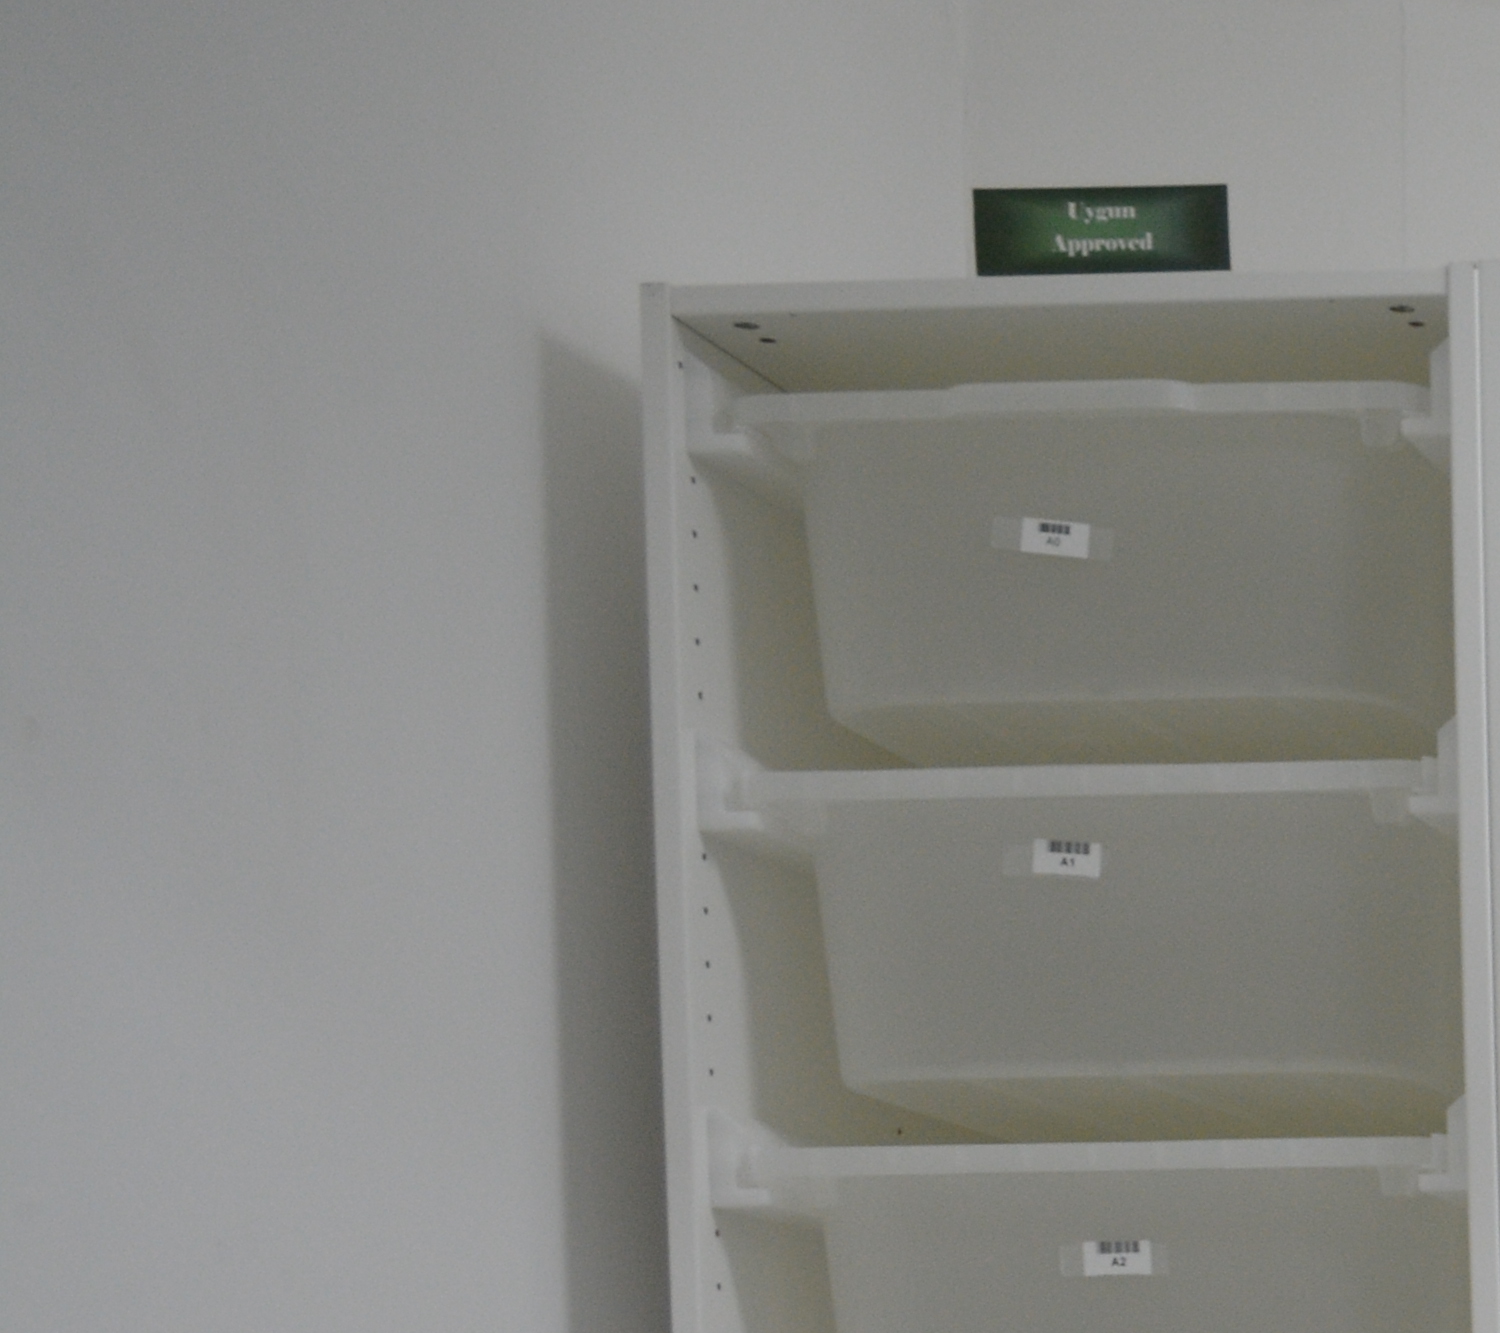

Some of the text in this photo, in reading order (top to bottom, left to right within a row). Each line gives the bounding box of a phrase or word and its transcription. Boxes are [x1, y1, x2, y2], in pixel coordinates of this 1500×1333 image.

[1067, 202, 1136, 222] Uygun
[1053, 232, 1153, 257] Approved
[1060, 856, 1075, 868] A1
[1111, 1256, 1127, 1268] A2
